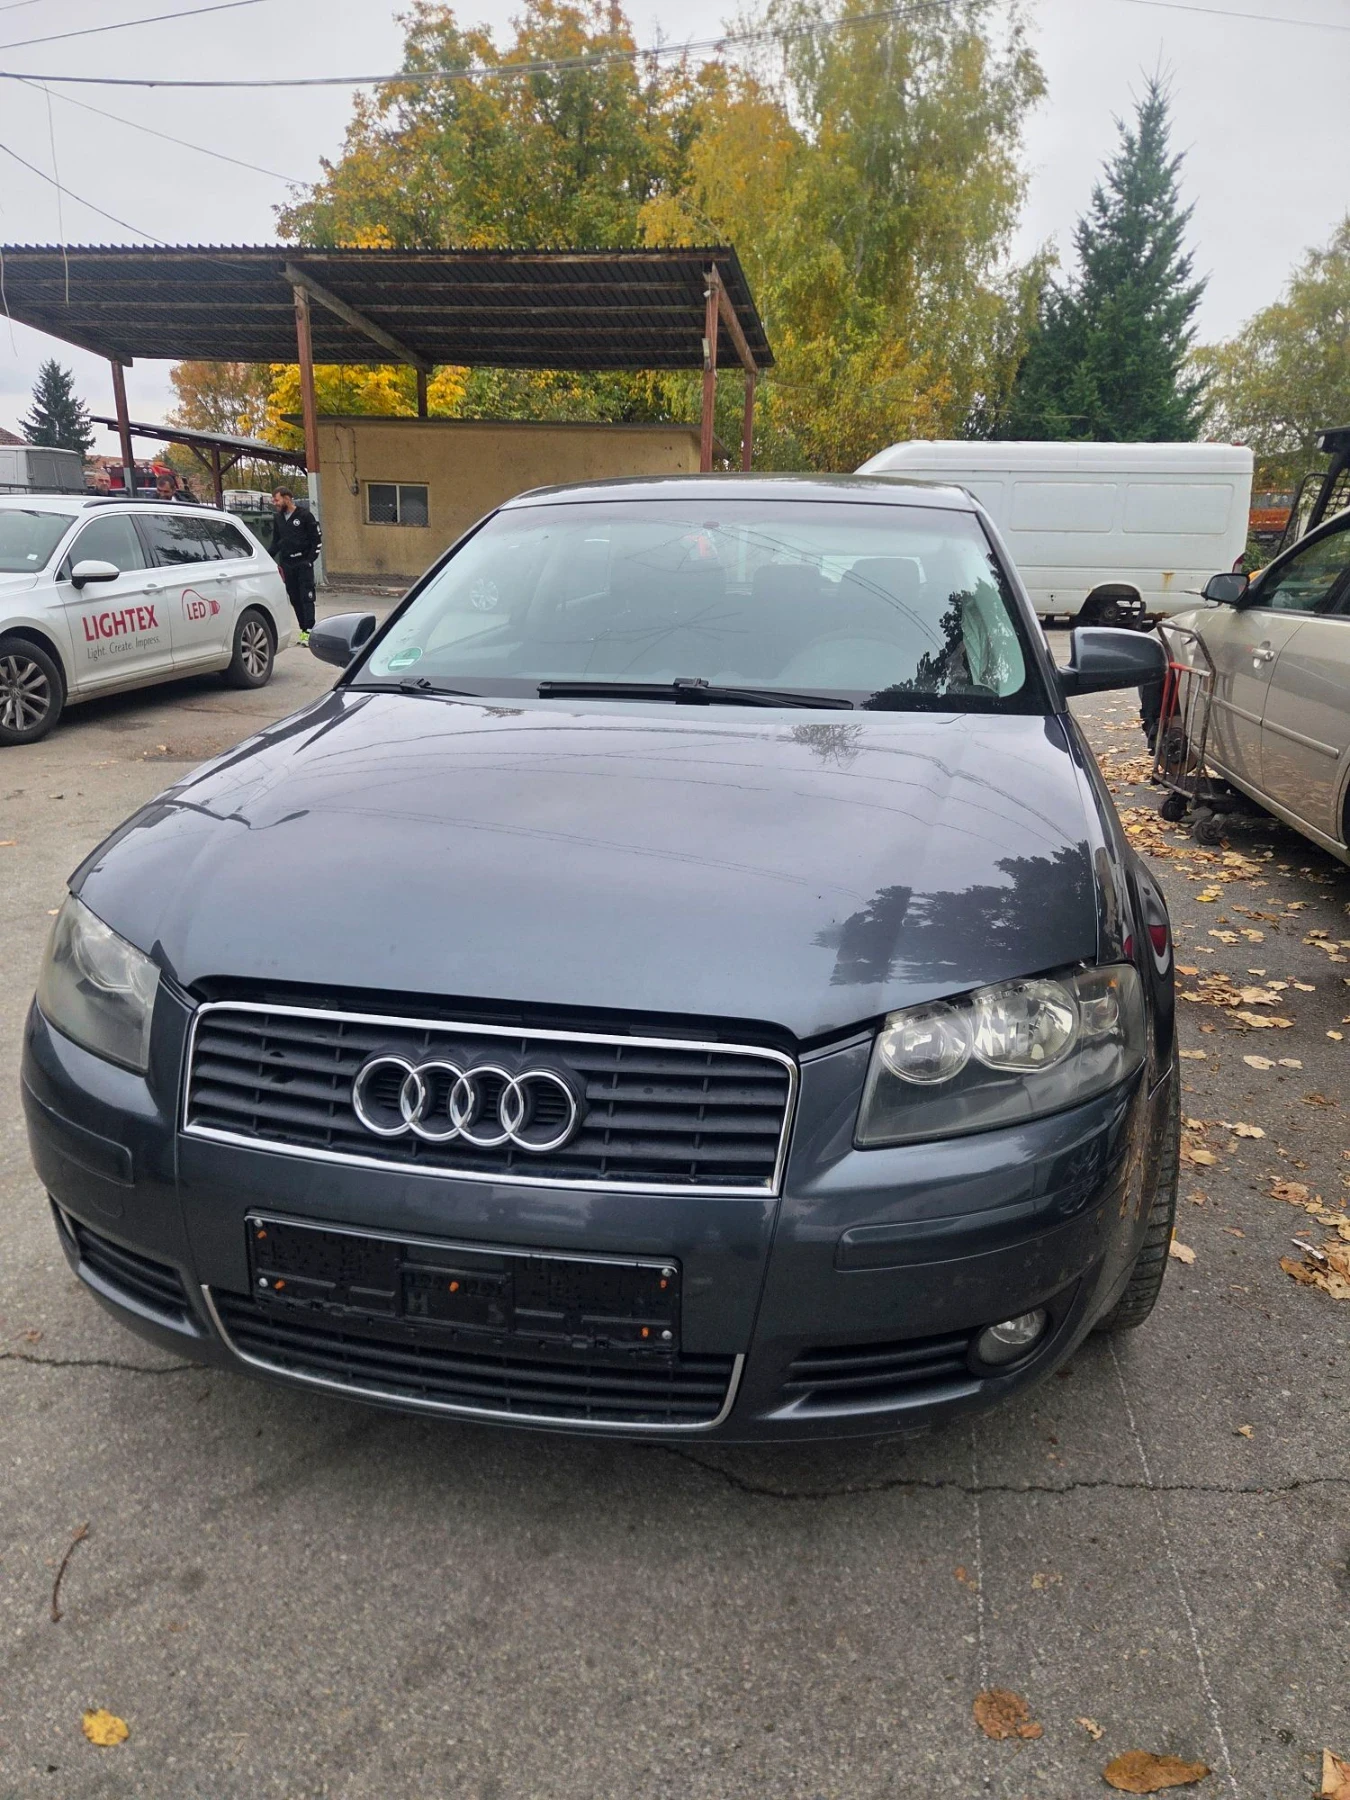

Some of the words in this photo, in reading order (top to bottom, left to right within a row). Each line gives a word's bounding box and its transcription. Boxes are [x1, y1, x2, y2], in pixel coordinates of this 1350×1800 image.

[187, 602, 206, 620] LED
[83, 605, 159, 641] LIGHTEX
[87, 646, 107, 661] Light.
[109, 640, 134, 654] Create.
